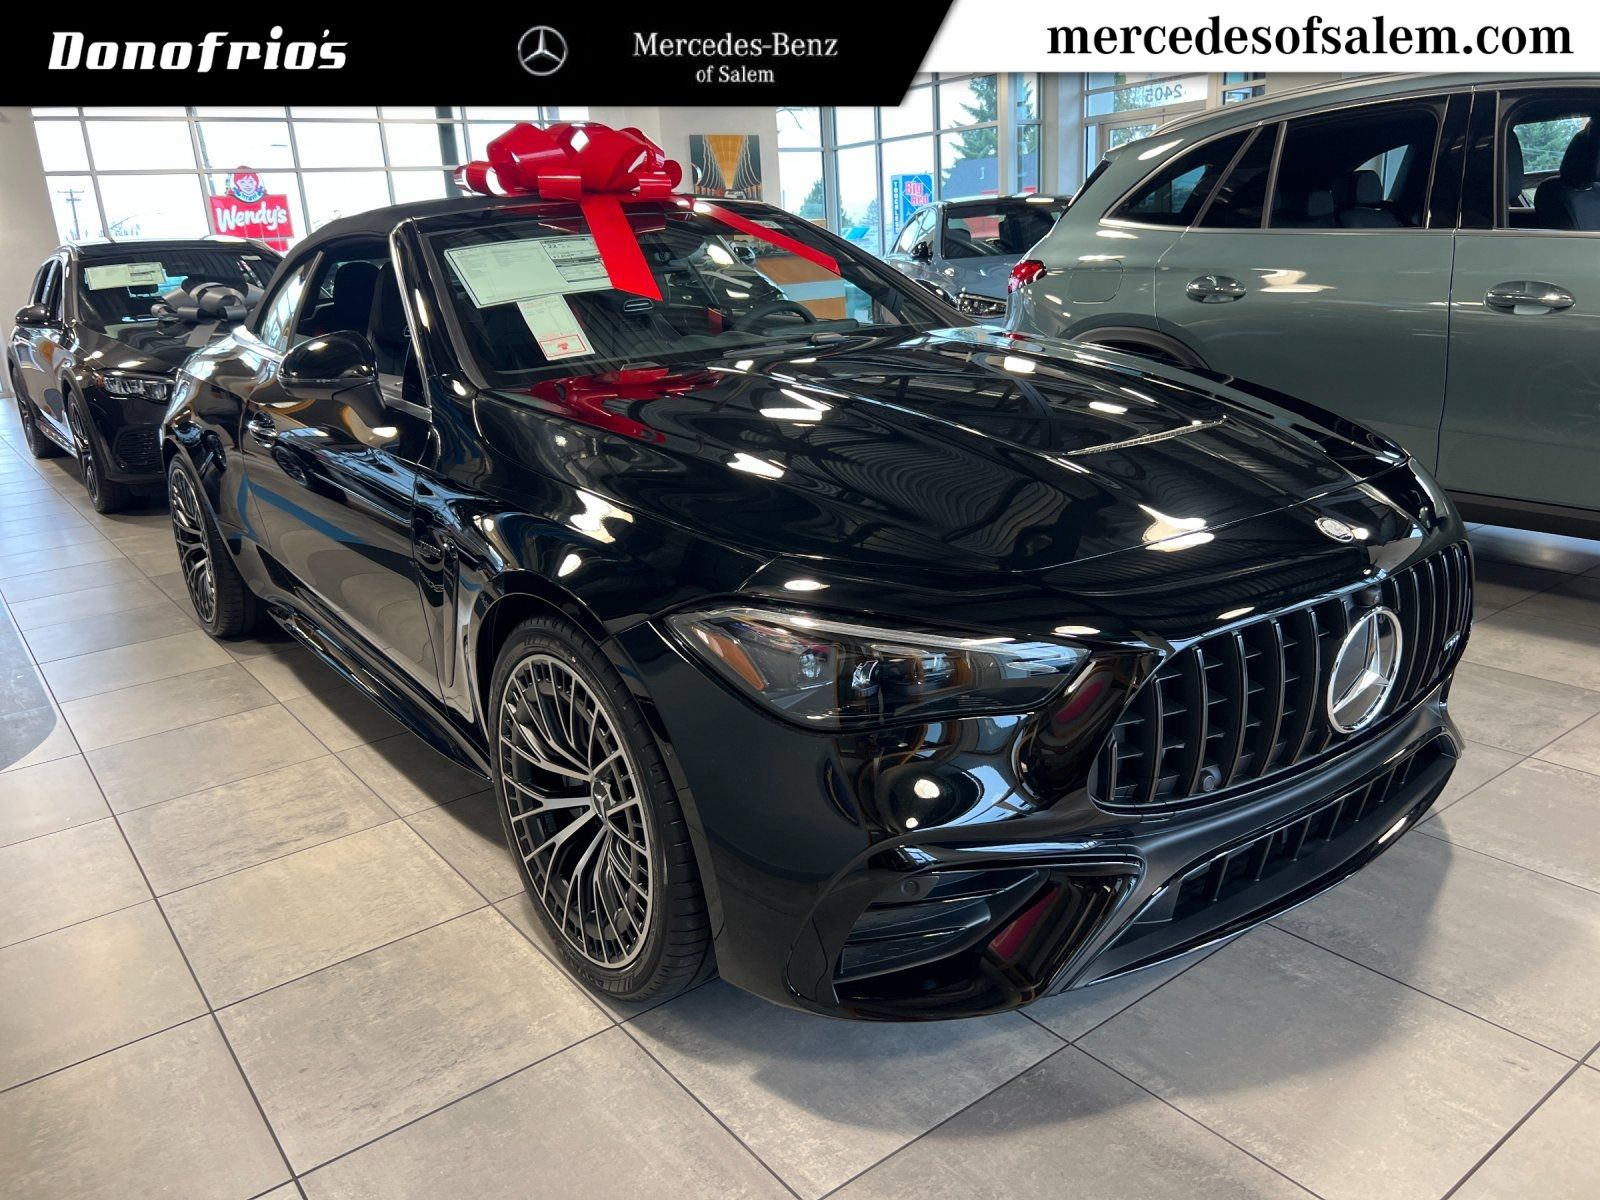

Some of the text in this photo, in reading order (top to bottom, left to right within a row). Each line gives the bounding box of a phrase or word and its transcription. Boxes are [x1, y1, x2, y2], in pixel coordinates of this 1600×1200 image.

[905, 181, 923, 196] Big
[911, 194, 929, 206] Red
[216, 201, 288, 233] Wendy's
